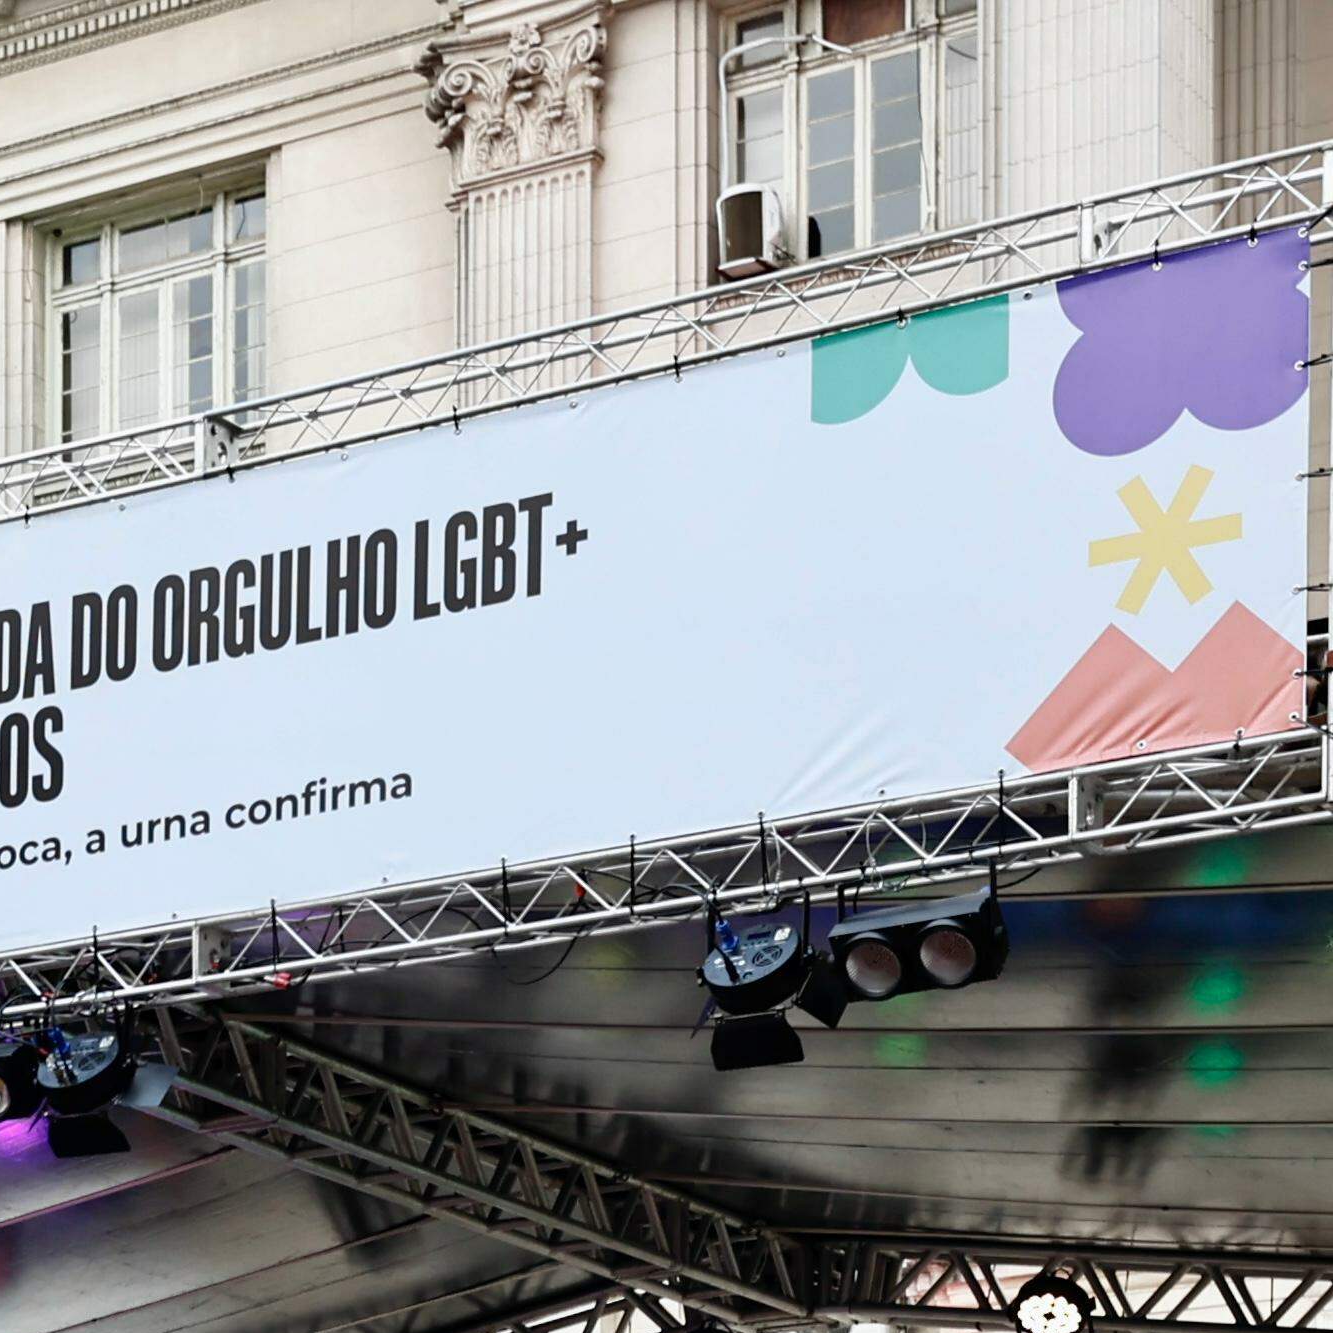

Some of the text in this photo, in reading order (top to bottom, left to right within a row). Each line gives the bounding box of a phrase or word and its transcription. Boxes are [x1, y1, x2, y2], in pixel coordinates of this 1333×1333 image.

[70, 584, 138, 691] DO
[152, 528, 398, 673] ORGULHO
[413, 492, 588, 621] LGBT+
[85, 829, 106, 855] a
[121, 810, 211, 848] urna
[225, 772, 412, 829] confirma
